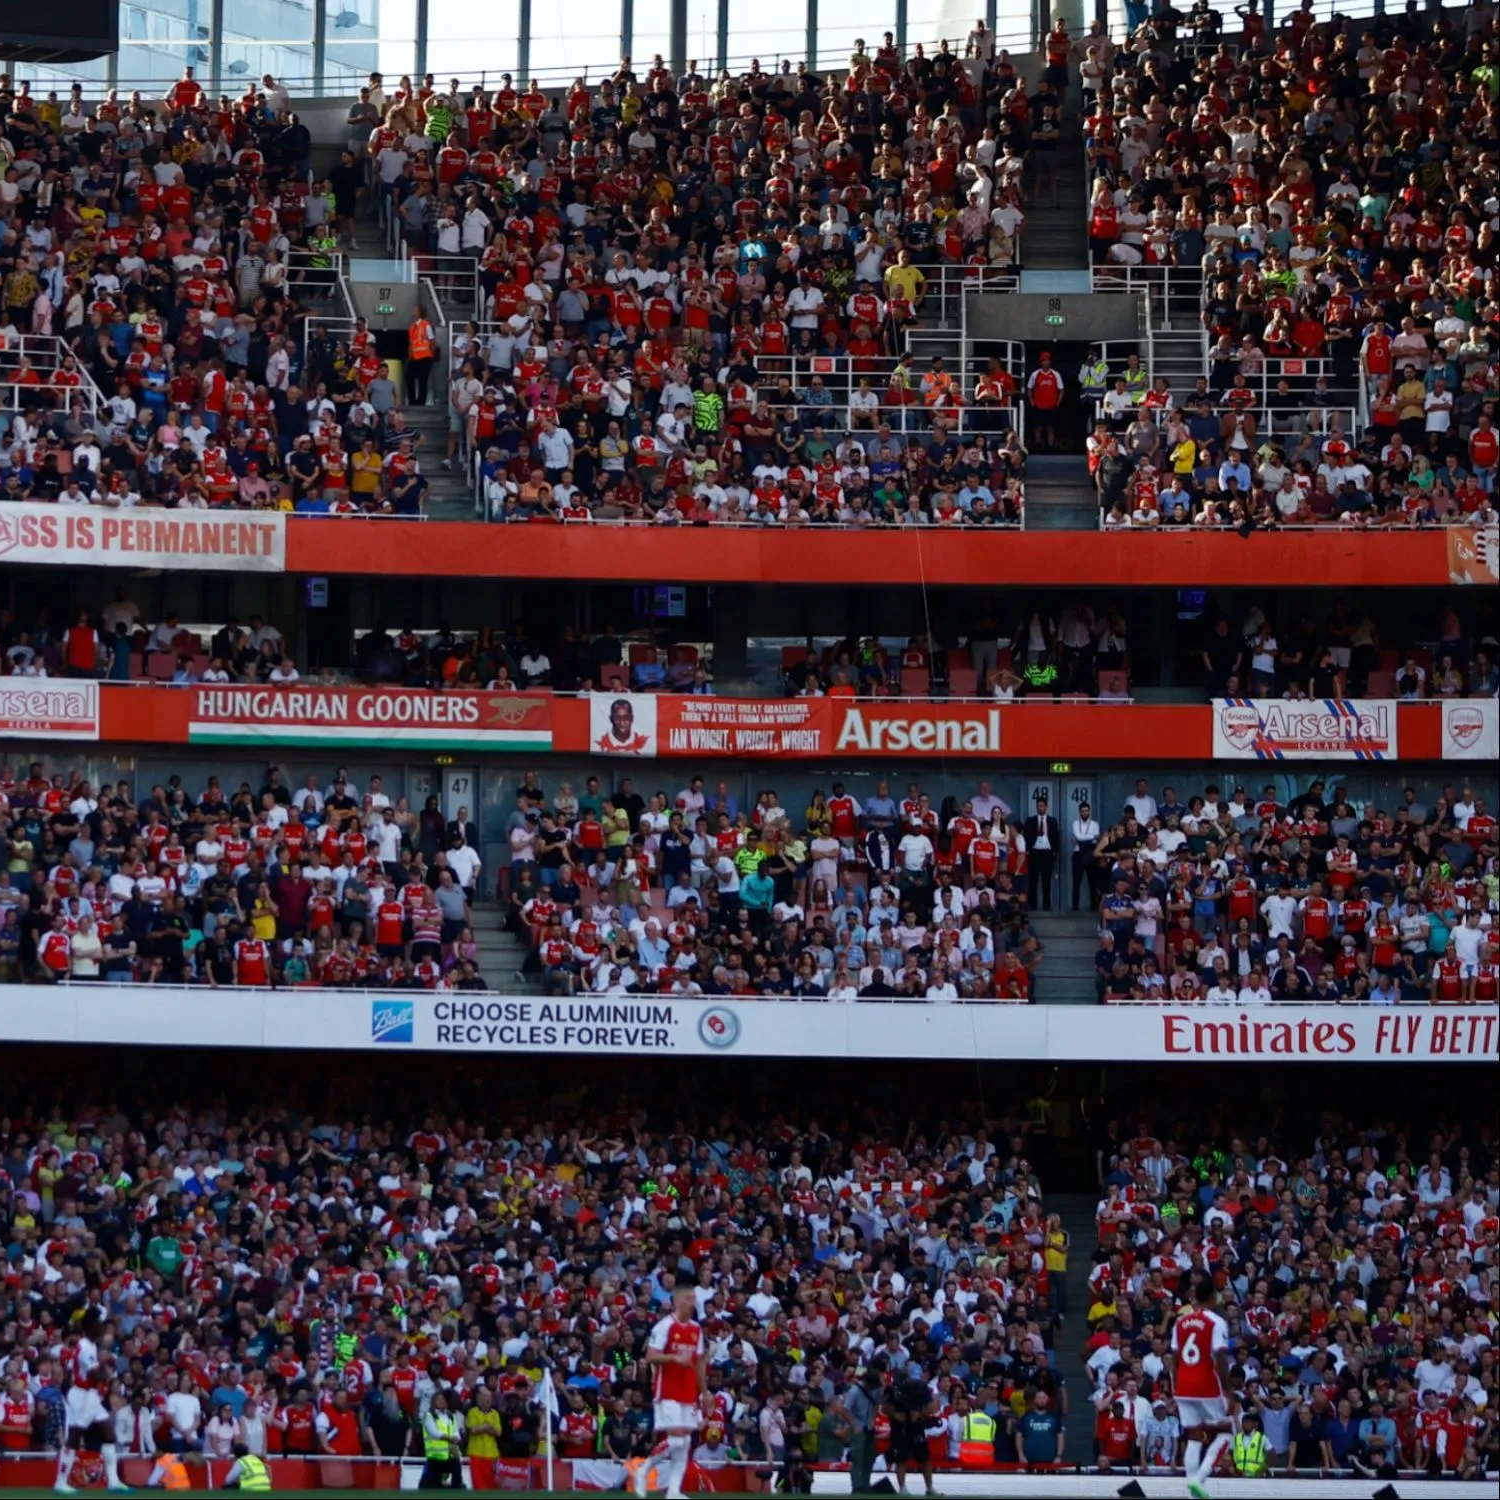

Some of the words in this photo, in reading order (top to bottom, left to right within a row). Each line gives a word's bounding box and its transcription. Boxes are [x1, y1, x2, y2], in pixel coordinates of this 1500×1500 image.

[380, 288, 391, 300] 97
[66, 516, 95, 549] IS
[102, 517, 277, 556] PERMANENT
[198, 690, 348, 721] HUNGARIAN
[356, 695, 480, 723] GOONERS
[7, 720, 51, 730] KERALA
[836, 708, 1000, 752] Arsenal
[1263, 705, 1388, 740] Arsenal
[669, 728, 687, 750] IAN
[690, 728, 733, 752] WRIGHT,
[781, 730, 821, 751] WRIGHT
[1297, 741, 1346, 750] ICELAND
[452, 777, 469, 794] 47
[1032, 786, 1048, 801] 48
[1071, 786, 1088, 803] 48
[374, 1007, 413, 1031] Ball
[434, 1002, 532, 1023] CHOOSE
[538, 1004, 679, 1025] ALUMINIUM.
[436, 1025, 557, 1045] RECYCLES
[563, 1028, 675, 1048] FOREVER.
[1161, 1013, 1356, 1054] Emirates
[1375, 1015, 1422, 1054] FLY
[1429, 1015, 1498, 1054] BETT
[1182, 1332, 1200, 1366] 6
